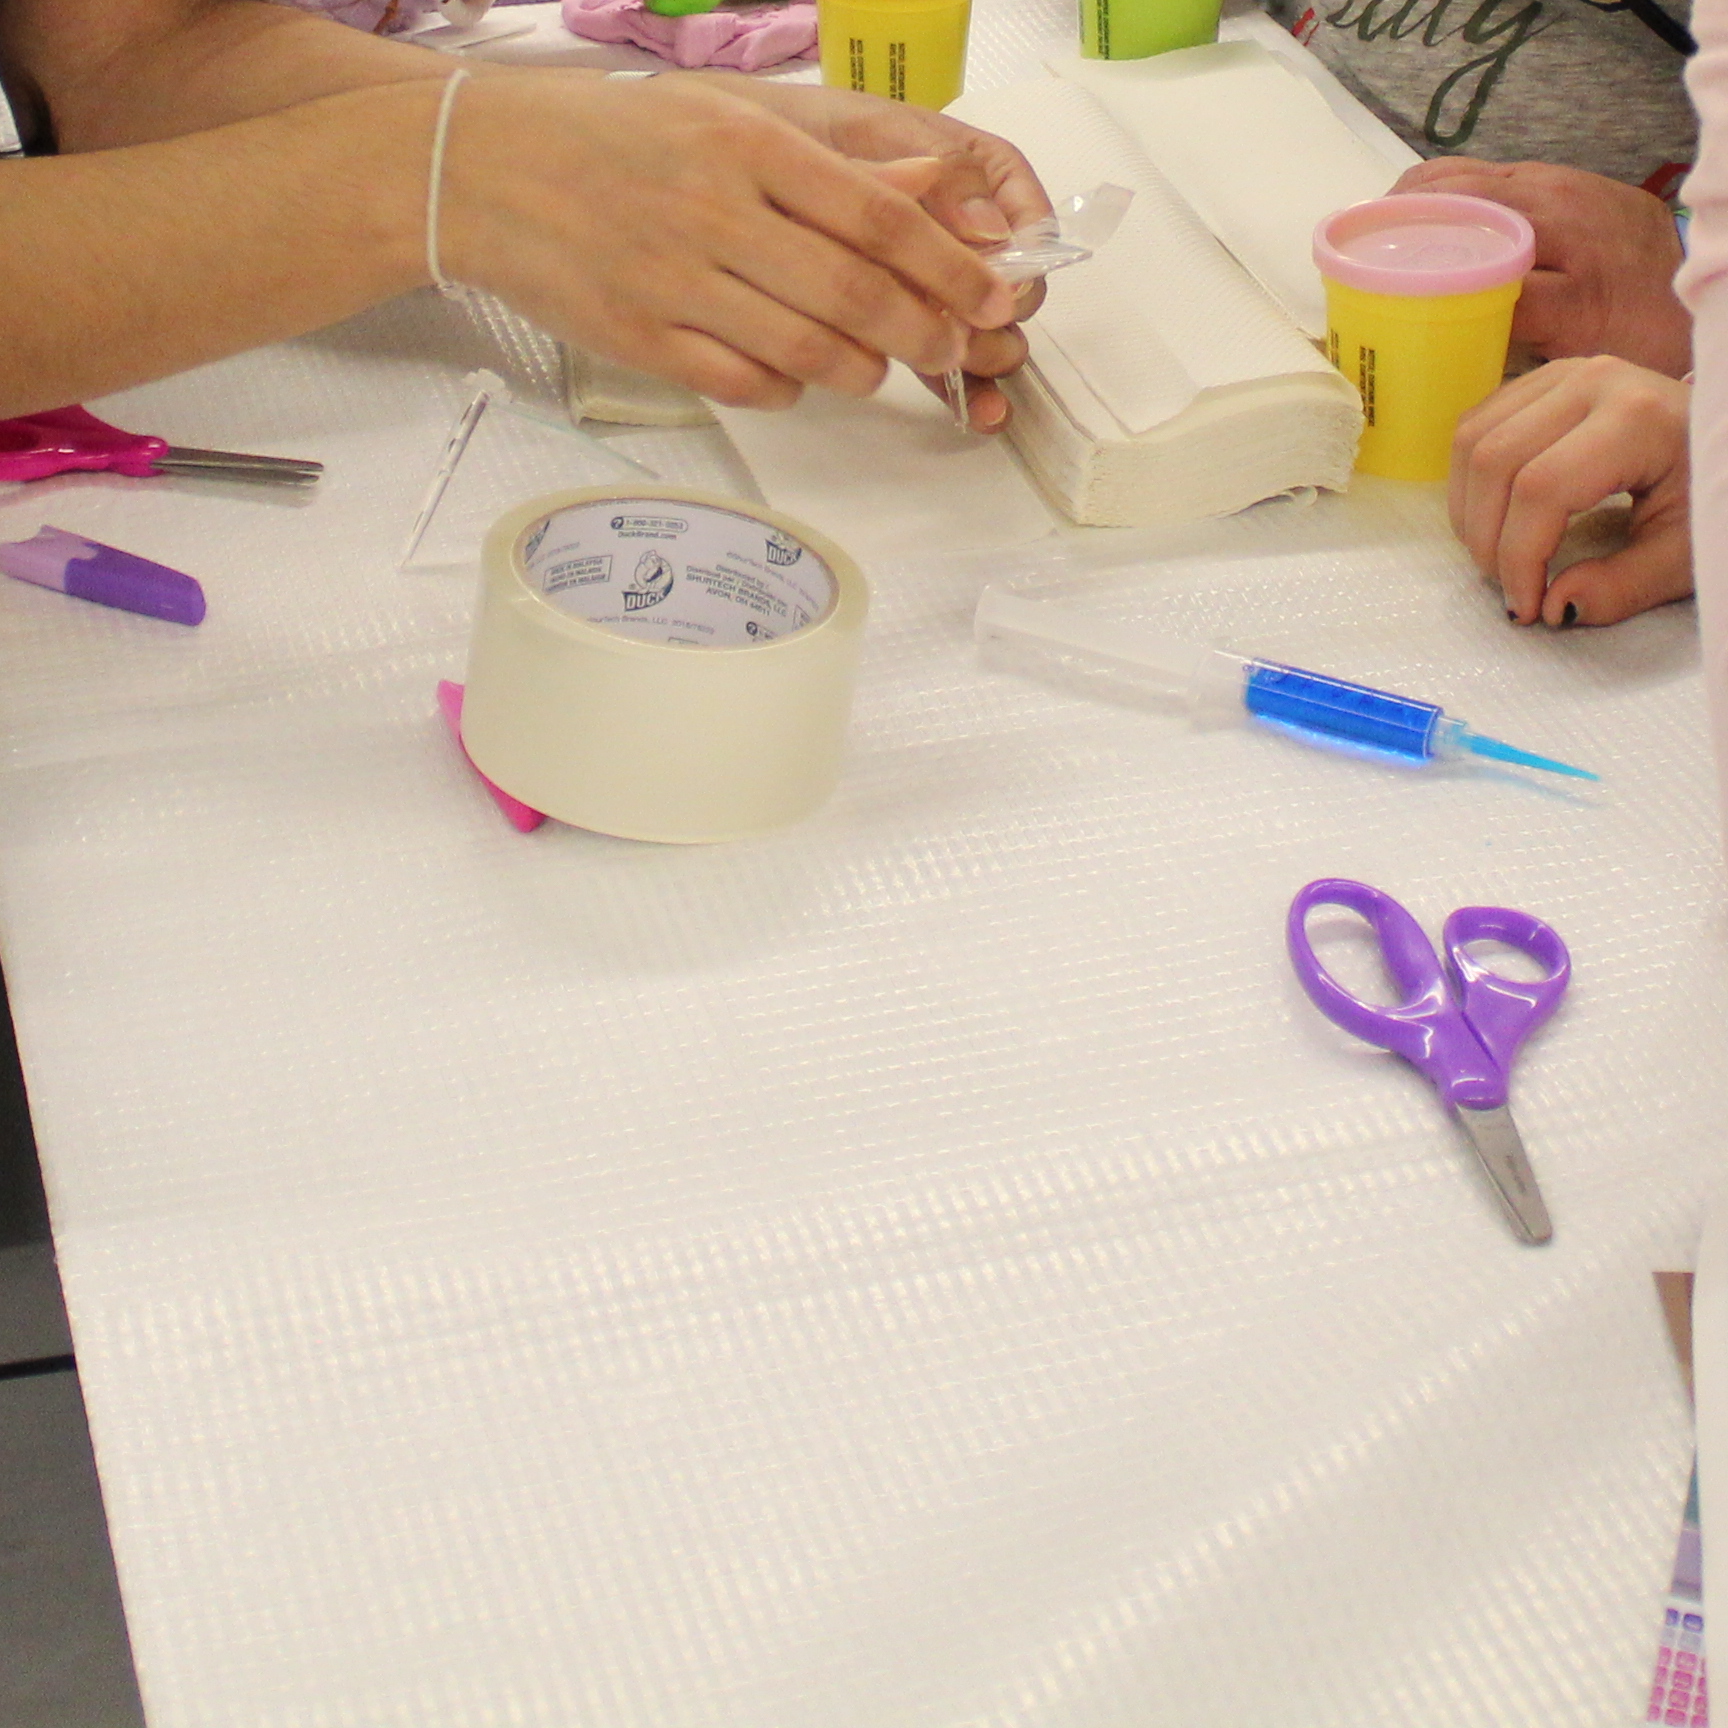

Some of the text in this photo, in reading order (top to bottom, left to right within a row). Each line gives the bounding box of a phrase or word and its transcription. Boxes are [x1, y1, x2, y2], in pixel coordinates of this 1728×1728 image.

[617, 531, 677, 540] DuckBrand.com
[768, 545, 798, 565] DUCK
[686, 574, 735, 592] SHURTECH
[627, 592, 665, 609] DUCK
